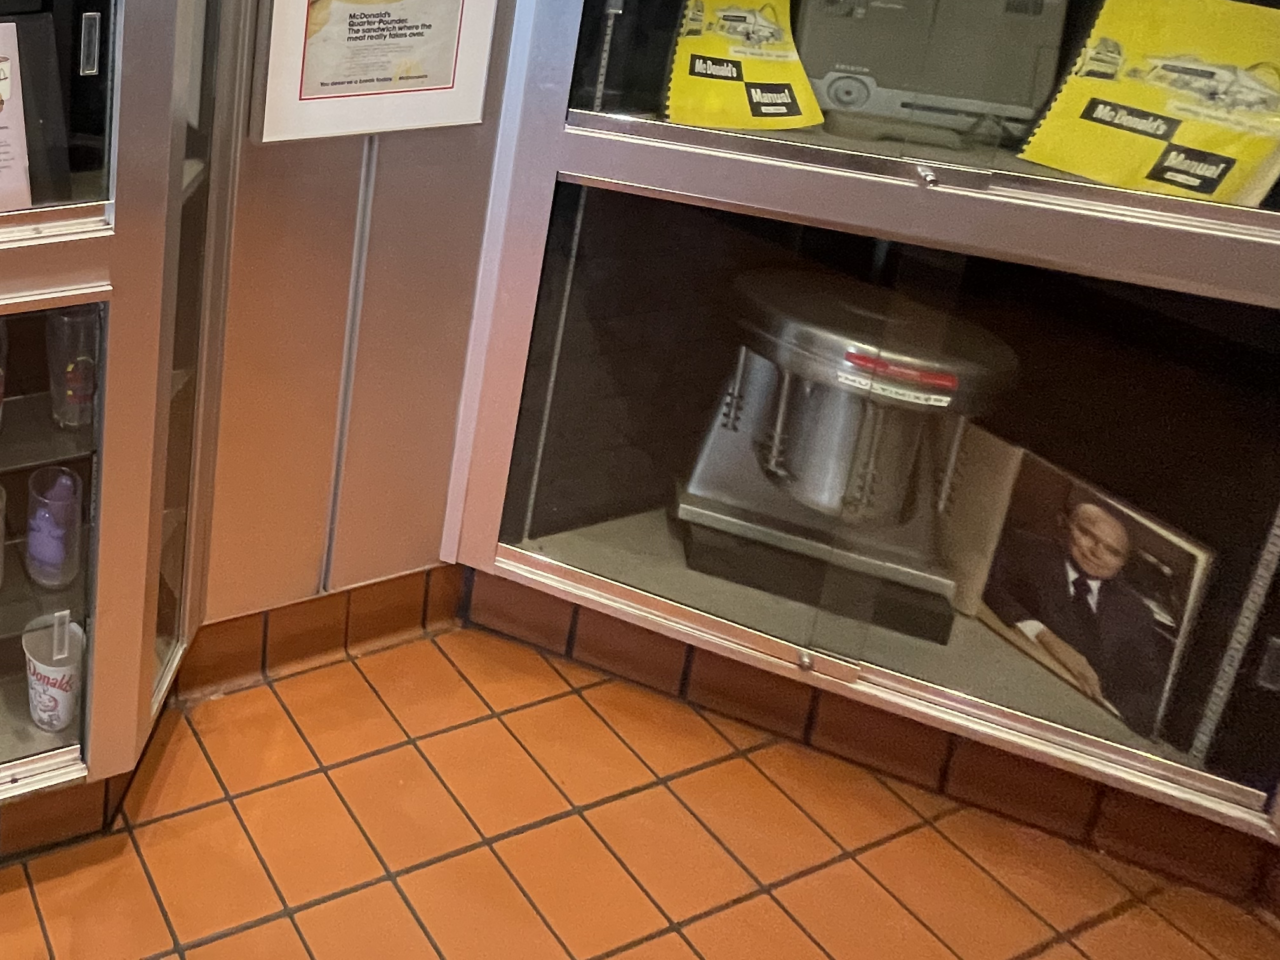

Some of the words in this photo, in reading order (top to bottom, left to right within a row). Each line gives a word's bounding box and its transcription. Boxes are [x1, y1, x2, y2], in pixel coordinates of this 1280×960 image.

[348, 11, 391, 20] McDonald's
[348, 27, 360, 35] The
[361, 25, 397, 34] sandwich
[347, 34, 366, 42] meat
[367, 33, 388, 41] really
[695, 58, 737, 78] McDonald's
[750, 88, 792, 103] Manual
[1164, 151, 1226, 179] Manual
